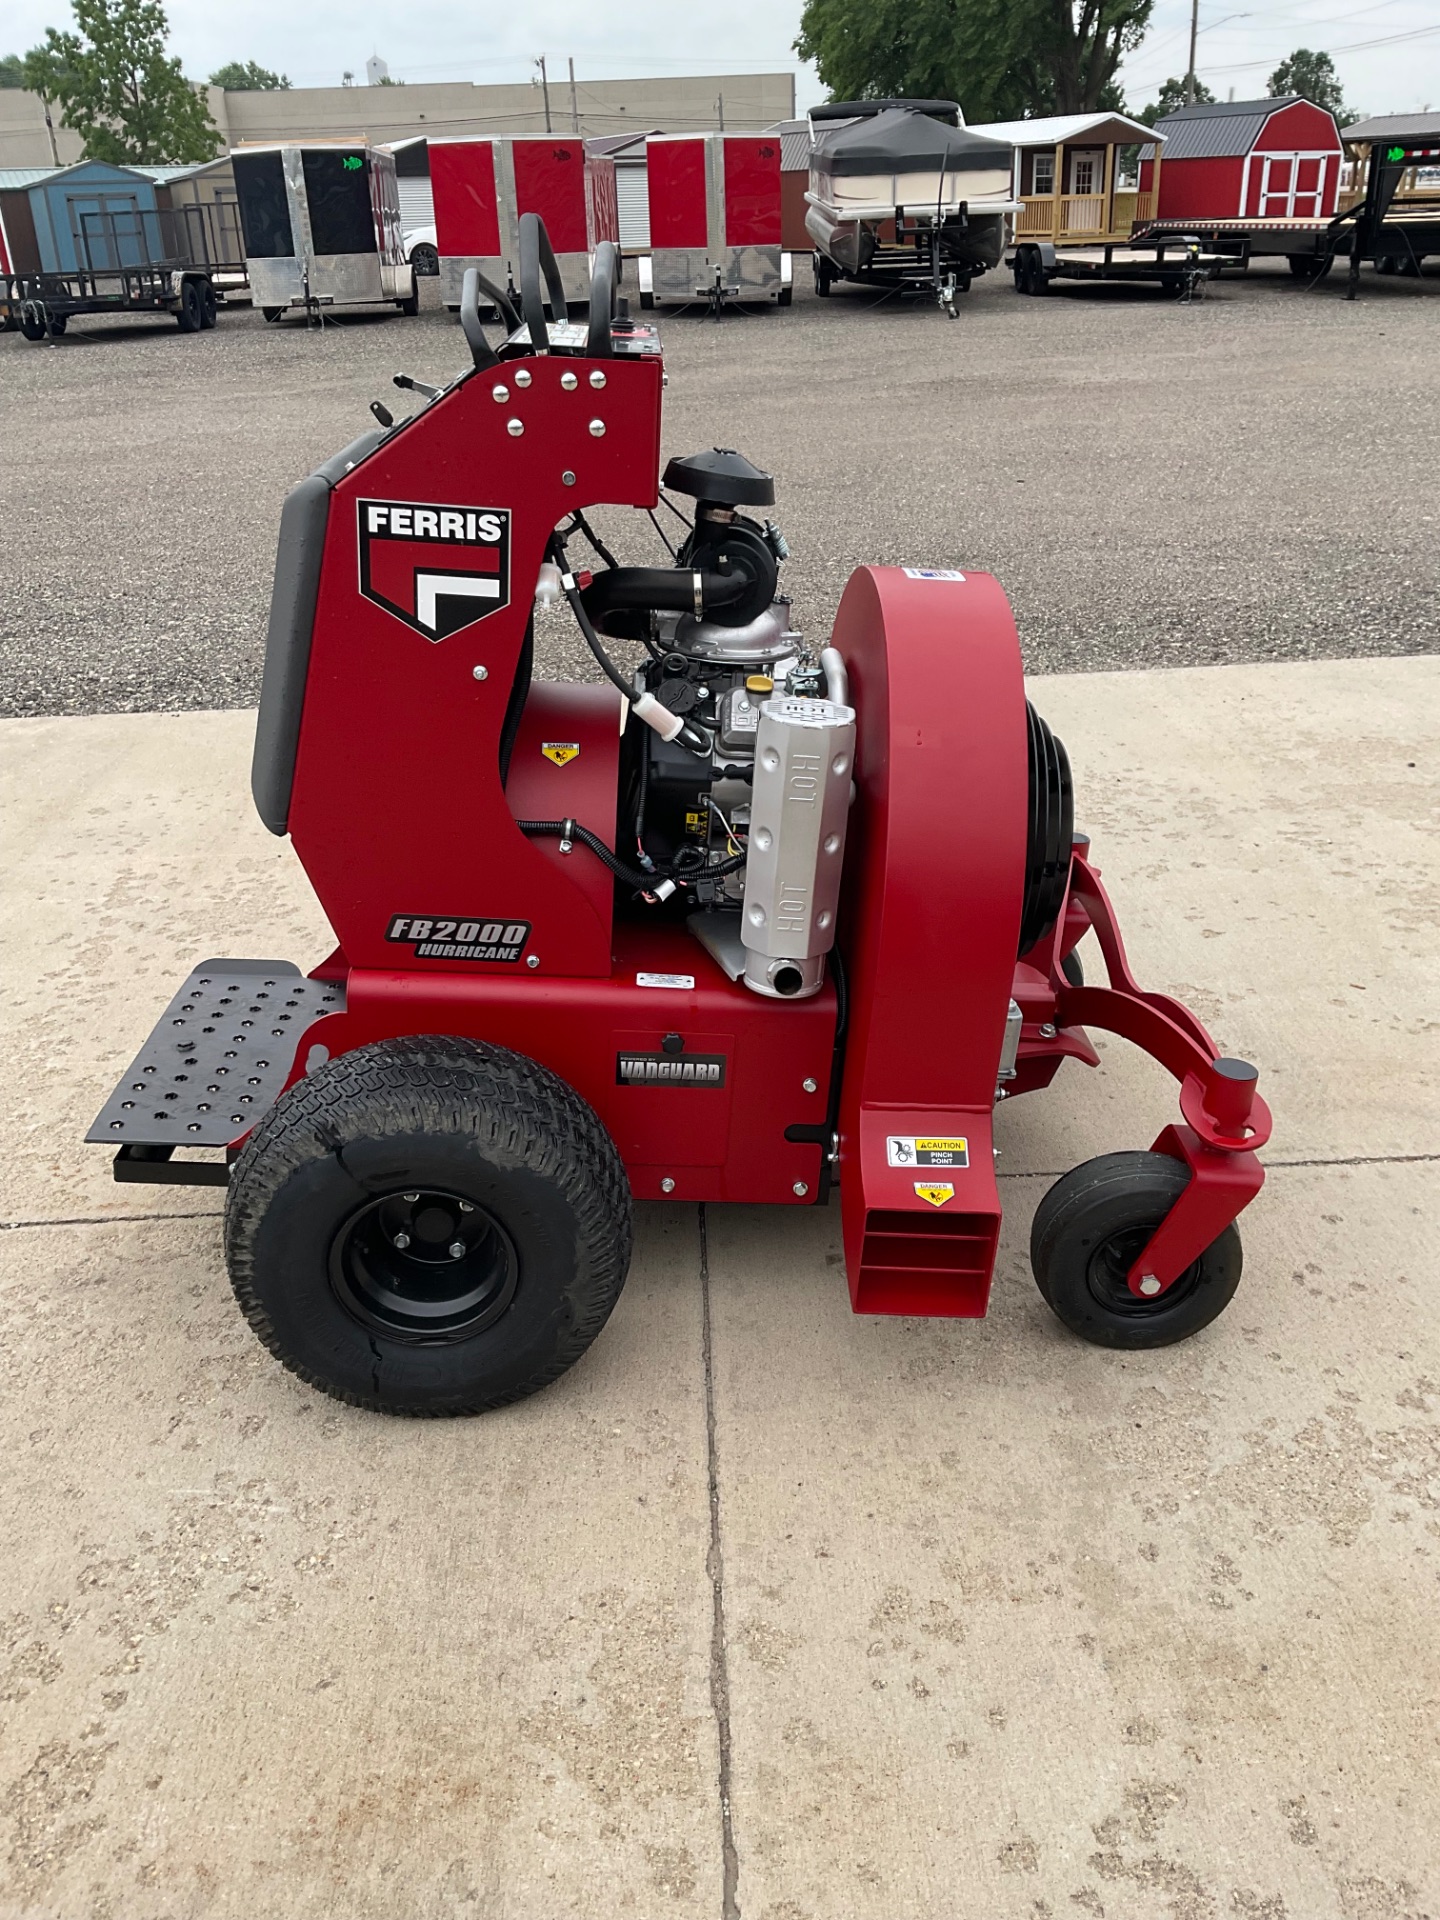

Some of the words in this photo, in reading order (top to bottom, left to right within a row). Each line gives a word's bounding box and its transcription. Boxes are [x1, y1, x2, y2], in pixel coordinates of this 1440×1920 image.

[368, 506, 501, 542] FERRIS
[788, 754, 821, 810] HOT
[776, 881, 808, 932] HOT
[390, 918, 527, 945] FB2000
[418, 943, 519, 960] HURRICANE
[620, 1061, 720, 1081] VANGUARD
